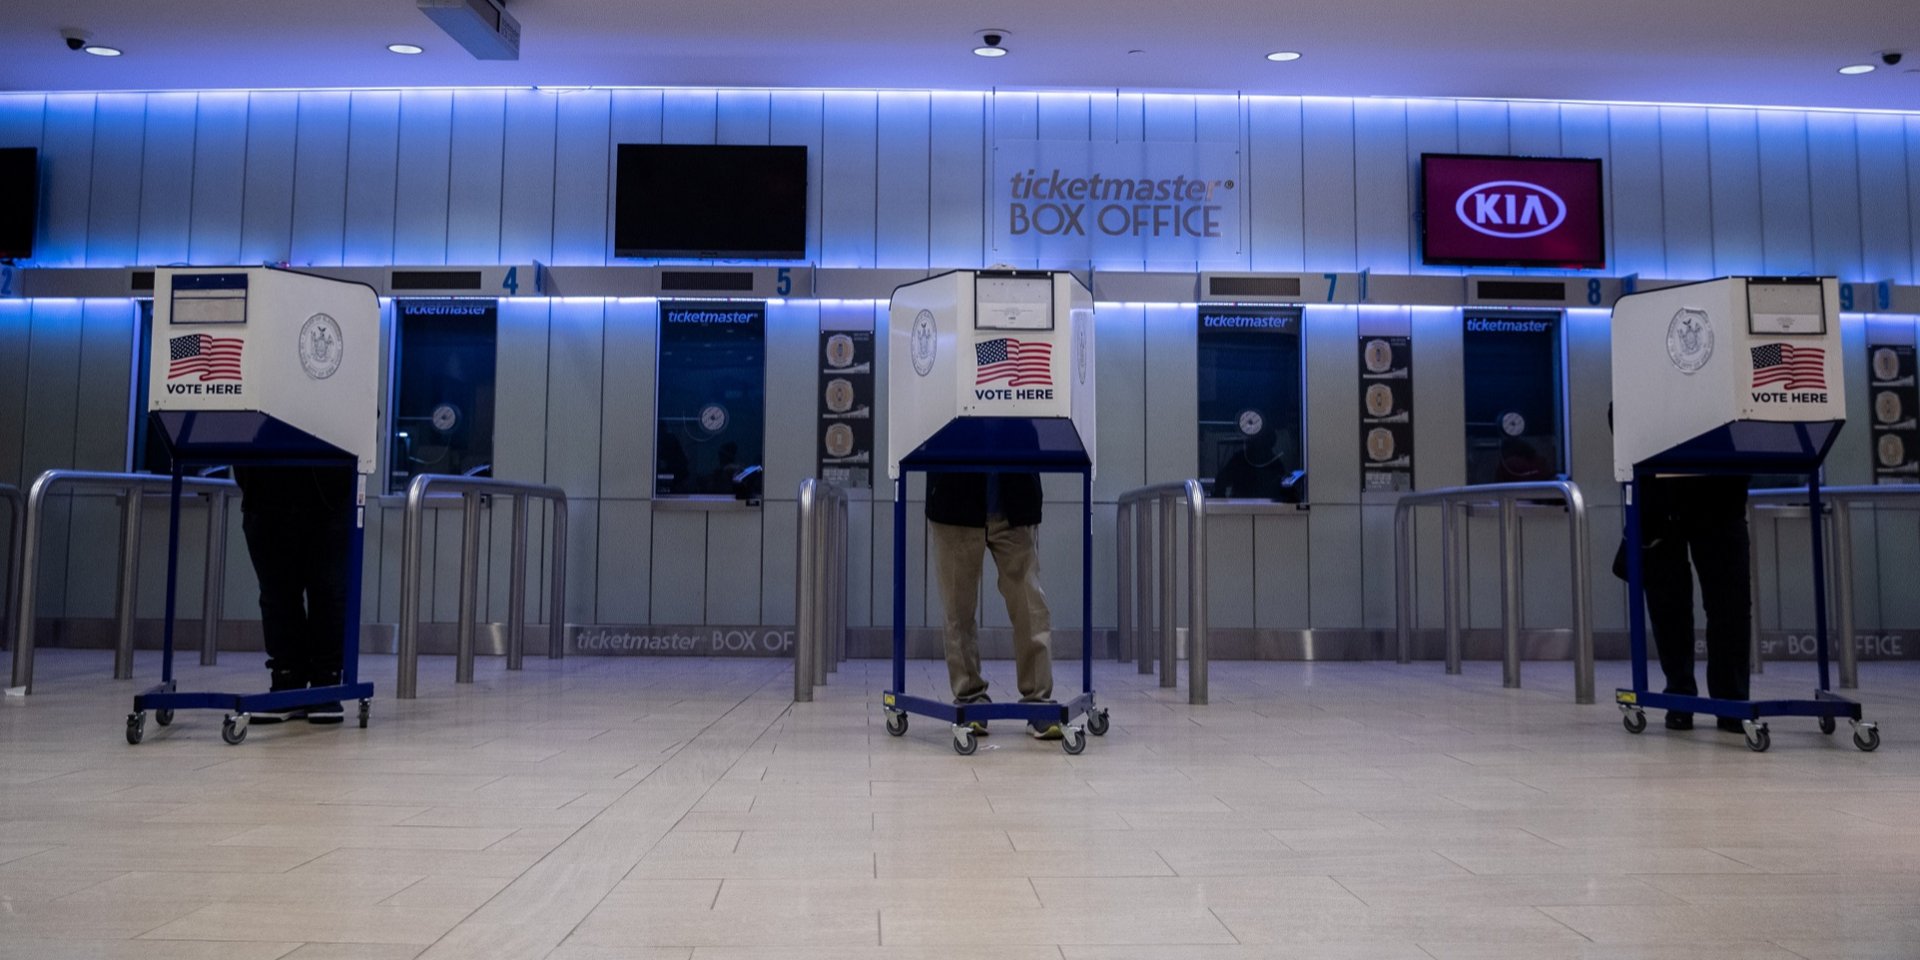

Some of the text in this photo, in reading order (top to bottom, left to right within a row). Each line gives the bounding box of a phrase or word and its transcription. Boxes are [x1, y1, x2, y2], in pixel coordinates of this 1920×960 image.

[1010, 203, 1222, 237] BOX OFFICE
[1474, 193, 1549, 225] KIA
[502, 266, 518, 295] 4
[776, 267, 791, 296] 5
[1324, 273, 1337, 303] 7
[1587, 278, 1601, 305] 8
[1840, 283, 1853, 311] 9
[166, 383, 242, 394] VOTE HERE
[975, 389, 1053, 400] VOTE HERE
[1752, 392, 1828, 403] VOTE HERE
[711, 631, 756, 650] BOX
[1788, 635, 1819, 655] BO
